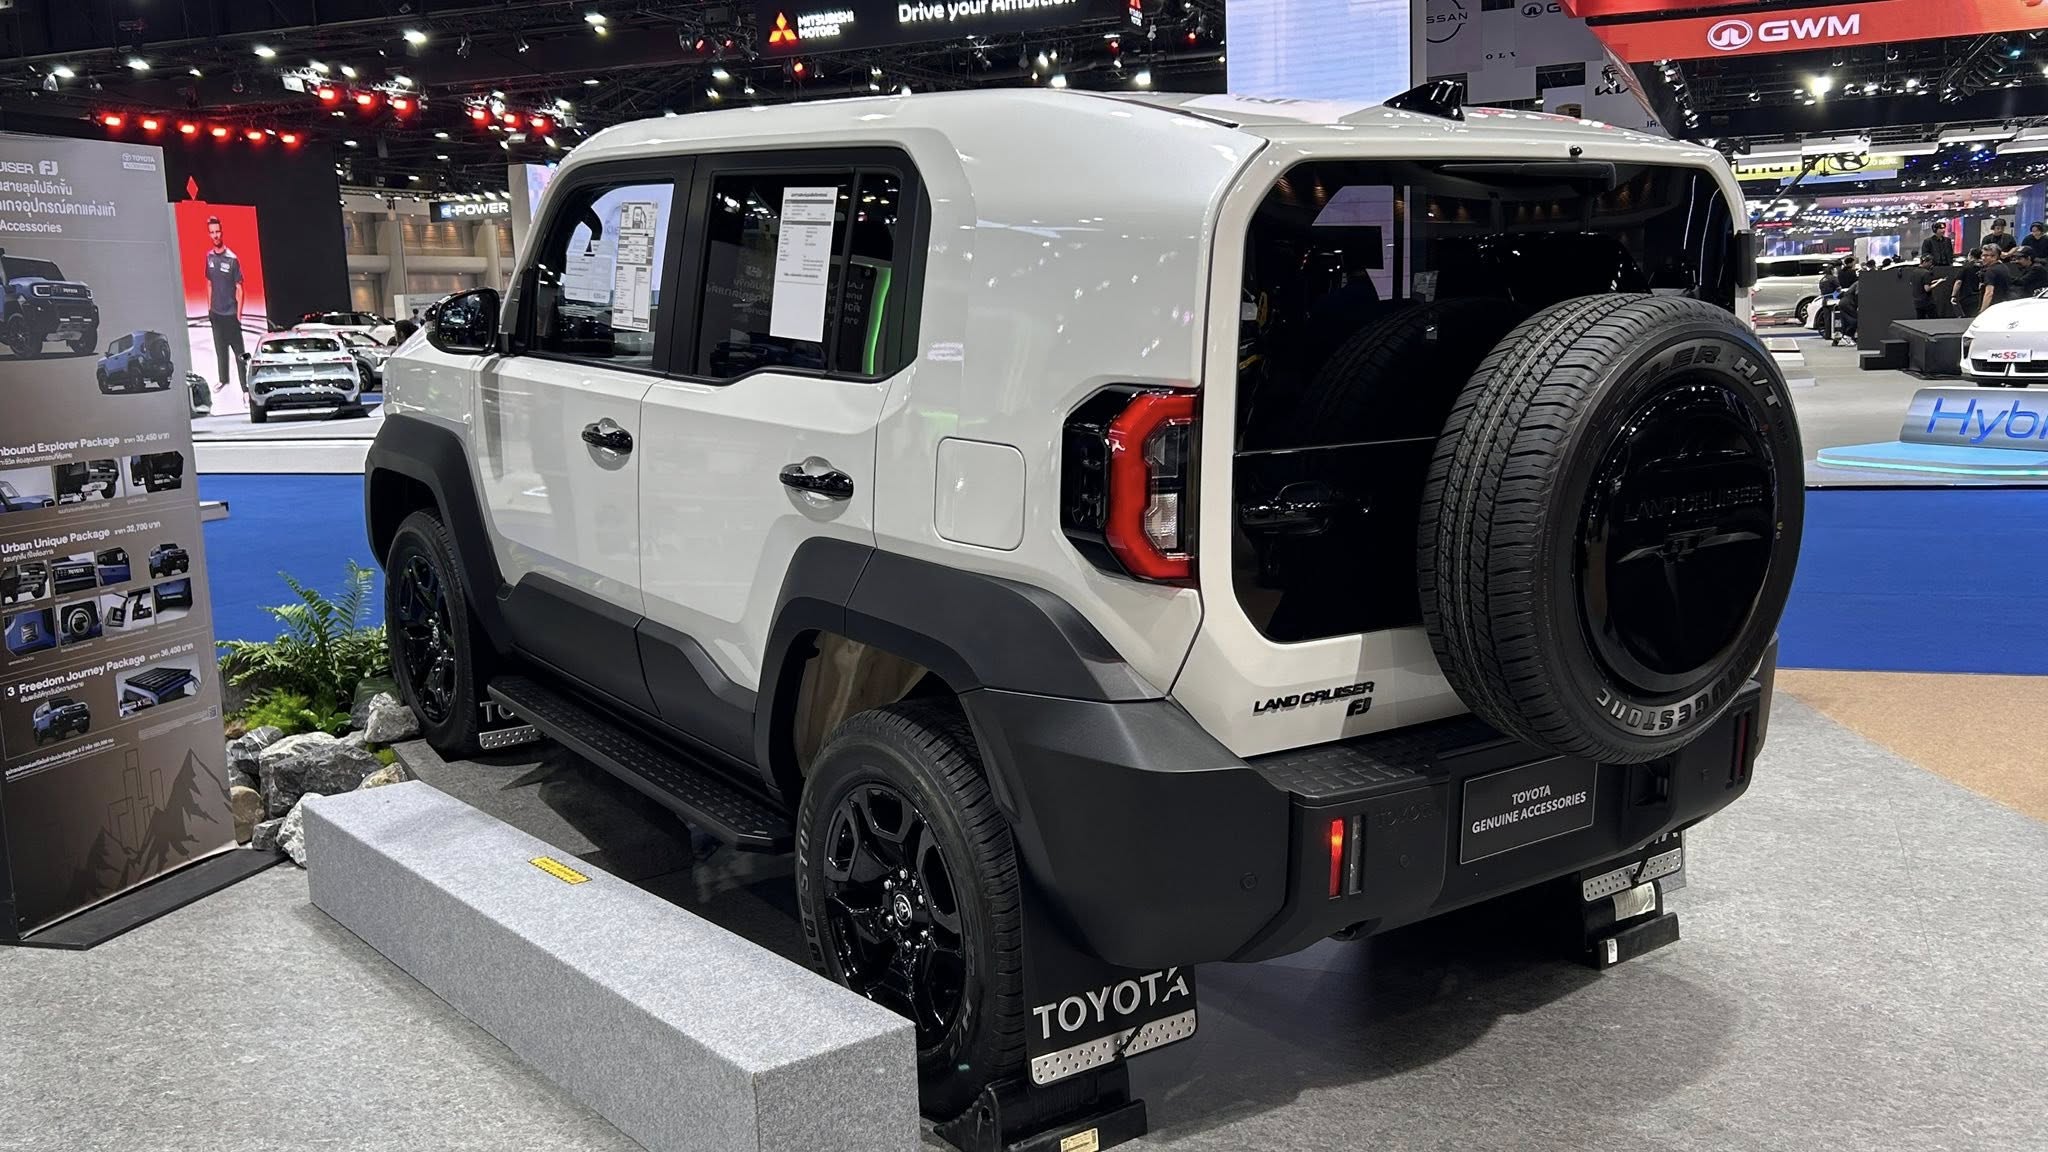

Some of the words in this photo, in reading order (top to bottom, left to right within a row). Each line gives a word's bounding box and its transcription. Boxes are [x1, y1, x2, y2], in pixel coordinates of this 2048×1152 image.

[798, 11, 854, 28] MITSUBISHI
[898, 3, 945, 23] Drive
[947, 0, 988, 21] your
[798, 25, 840, 39] MOTORS
[1758, 13, 1861, 42] GWM
[441, 202, 509, 218] e-POWER
[1869, 196, 1900, 204] Warranty
[0, 219, 62, 233] Accessories
[1733, 356, 1783, 408] H/T
[38, 441, 79, 454] Explorer
[80, 436, 120, 448] Package
[1, 541, 33, 554] Urban
[34, 536, 68, 550] Unique
[69, 529, 110, 543] Package
[7, 686, 15, 697] 3
[19, 675, 65, 694] Freedom
[66, 664, 105, 682] Journey
[106, 654, 146, 672] Package
[1254, 695, 1300, 713] LAND
[1300, 681, 1376, 706] CRUISER
[1346, 697, 1372, 717] FJ
[1512, 784, 1551, 806] TOYOTA
[1472, 810, 1519, 834] GENUINE
[1520, 791, 1587, 821] ACCESSORIES
[1033, 966, 1190, 1040] TOYOTA
